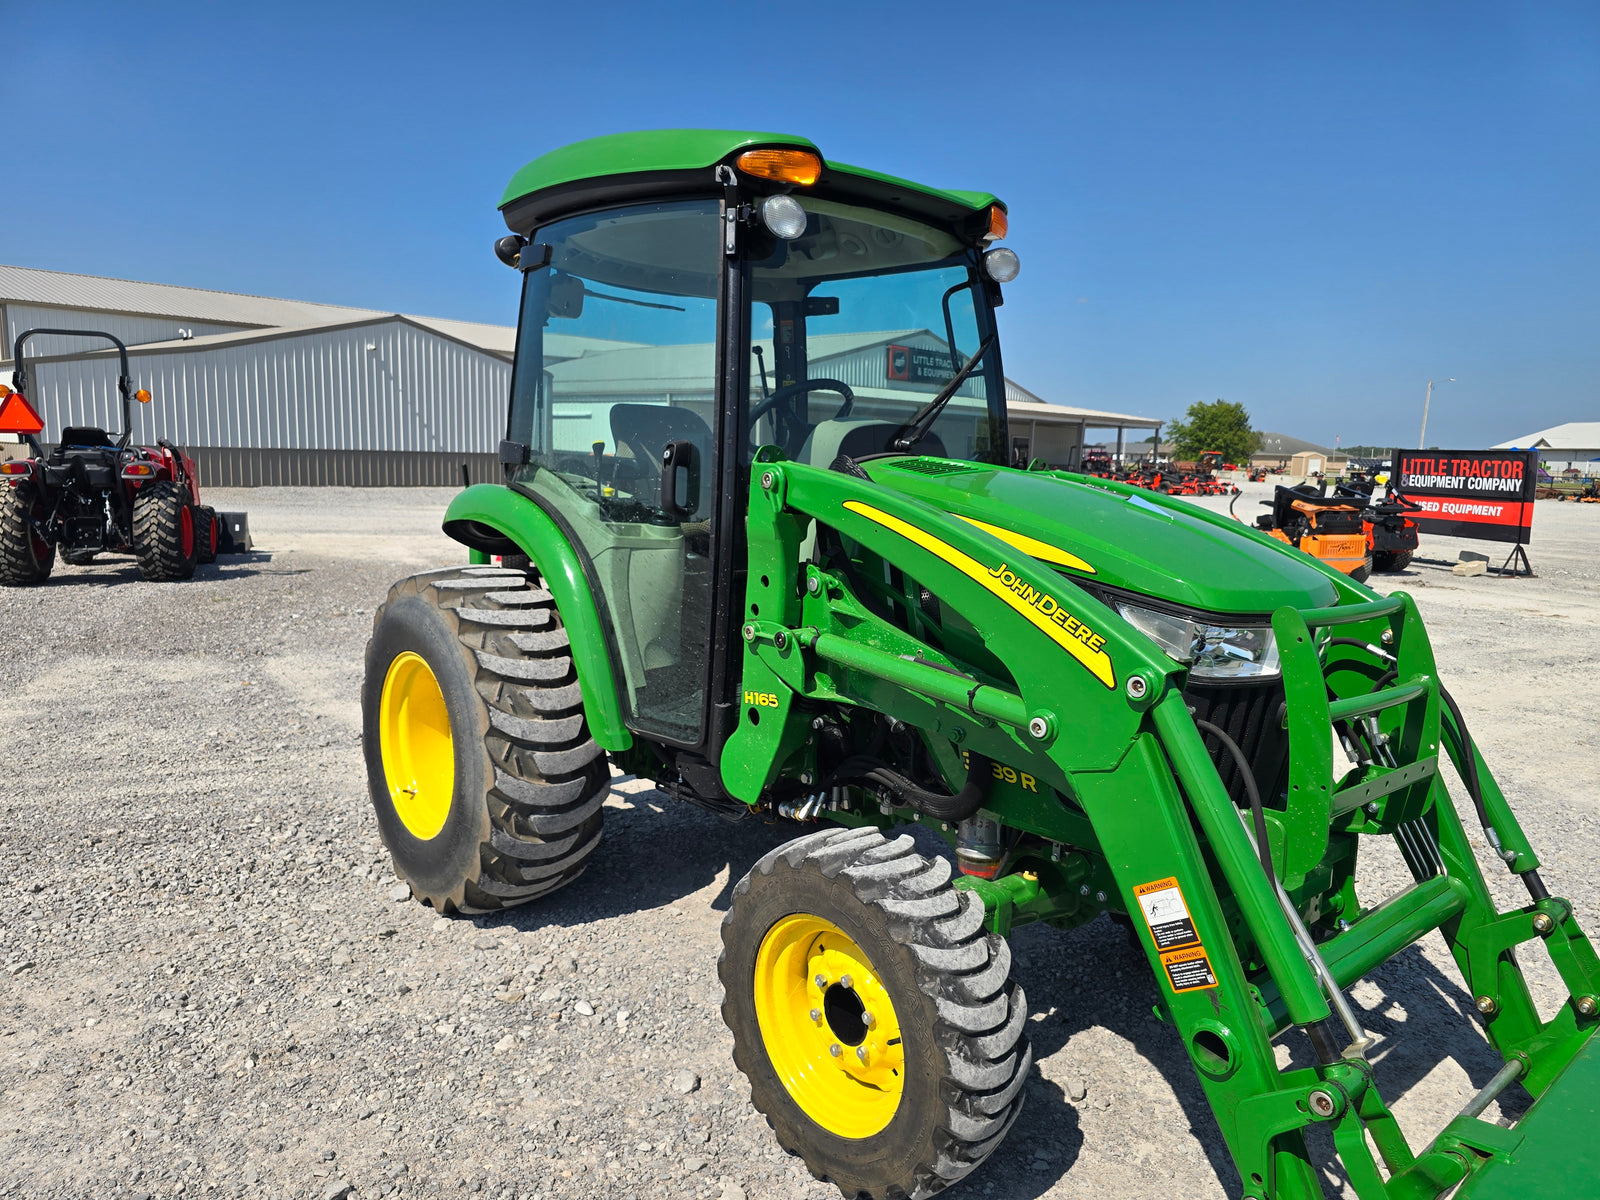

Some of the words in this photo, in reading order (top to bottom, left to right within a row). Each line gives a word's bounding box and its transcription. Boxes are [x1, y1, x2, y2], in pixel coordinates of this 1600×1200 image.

[913, 356, 934, 366] LITTLE
[1402, 458, 1447, 475] LITTLE
[1451, 459, 1524, 479] TRACTOR
[1401, 473, 1409, 487] &
[1409, 475, 1465, 489] EQUIPMENT
[1467, 476, 1523, 492] COMPANY
[1441, 502, 1503, 517] EQUIPMENT
[988, 563, 1042, 607] JOHN
[1035, 593, 1108, 654] DEERE
[744, 690, 779, 708] H165
[1145, 881, 1173, 892] WARNING
[1173, 951, 1202, 961] WARNING
